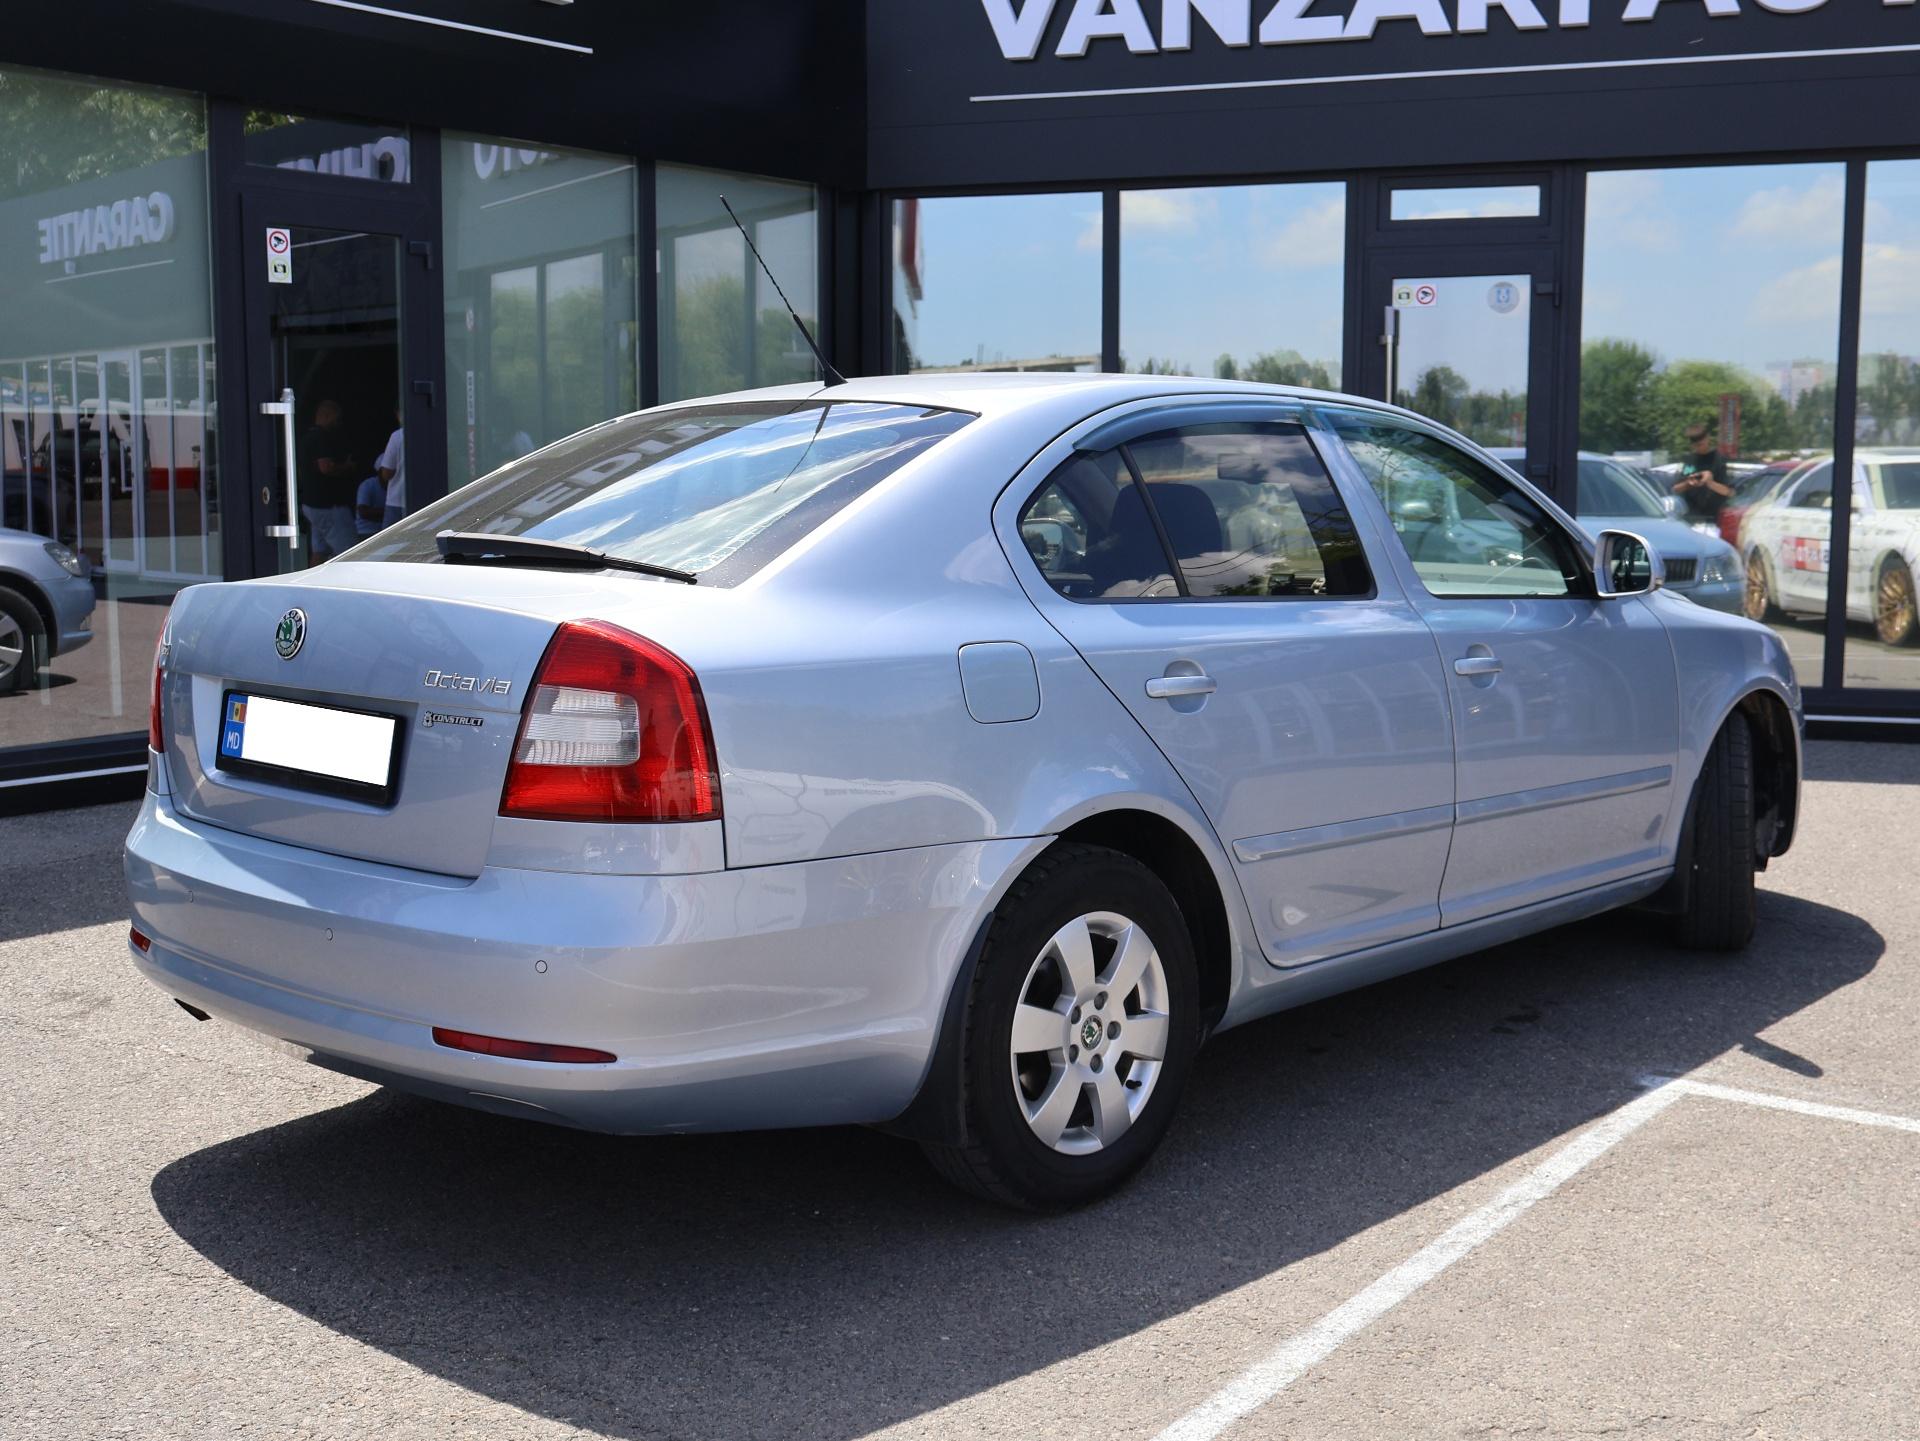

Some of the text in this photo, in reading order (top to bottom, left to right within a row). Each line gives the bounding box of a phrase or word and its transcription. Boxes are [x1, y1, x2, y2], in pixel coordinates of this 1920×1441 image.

[981, 0, 1590, 60] VANZ
[424, 670, 512, 695] Octavia
[432, 713, 484, 727] CONSTRUCT
[226, 731, 241, 750] MD
